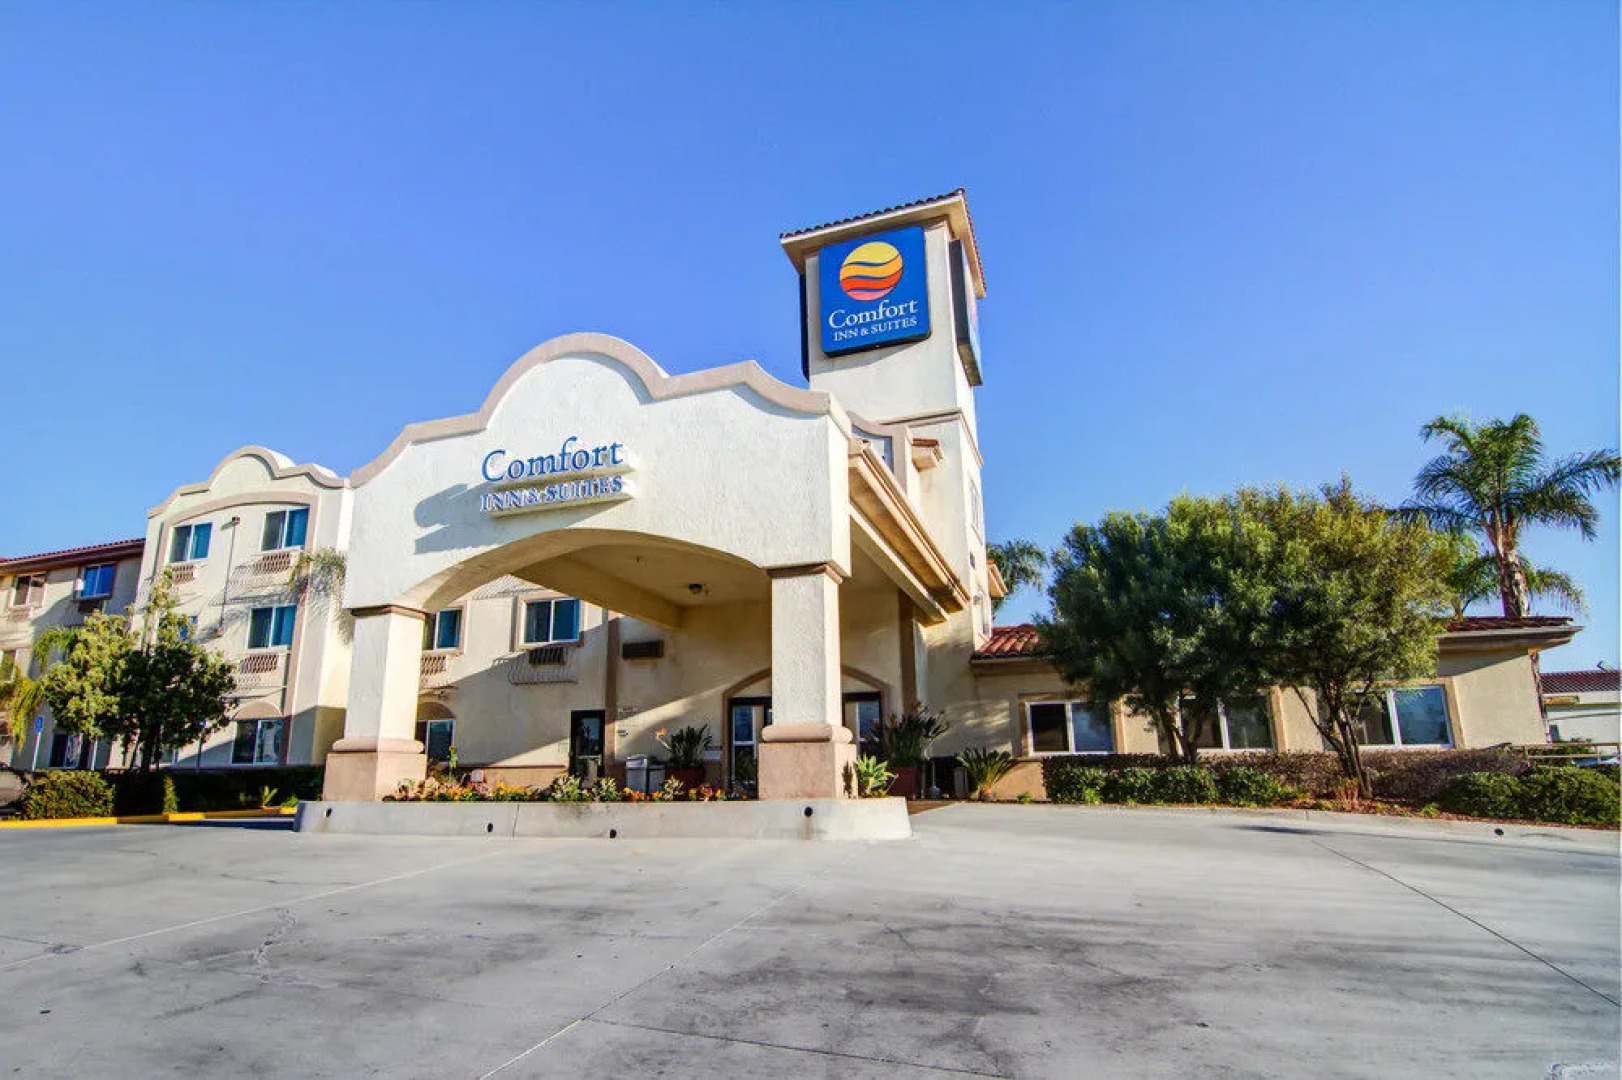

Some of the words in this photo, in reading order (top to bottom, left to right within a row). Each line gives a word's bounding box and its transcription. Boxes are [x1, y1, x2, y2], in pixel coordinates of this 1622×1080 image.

[829, 299, 919, 329] Comfort
[833, 327, 859, 341] INN
[860, 327, 869, 337] &
[870, 315, 918, 334] SUITES
[481, 435, 624, 482] Comfort
[480, 488, 526, 512] INN
[527, 487, 540, 504] &
[545, 474, 623, 502] SUITES
